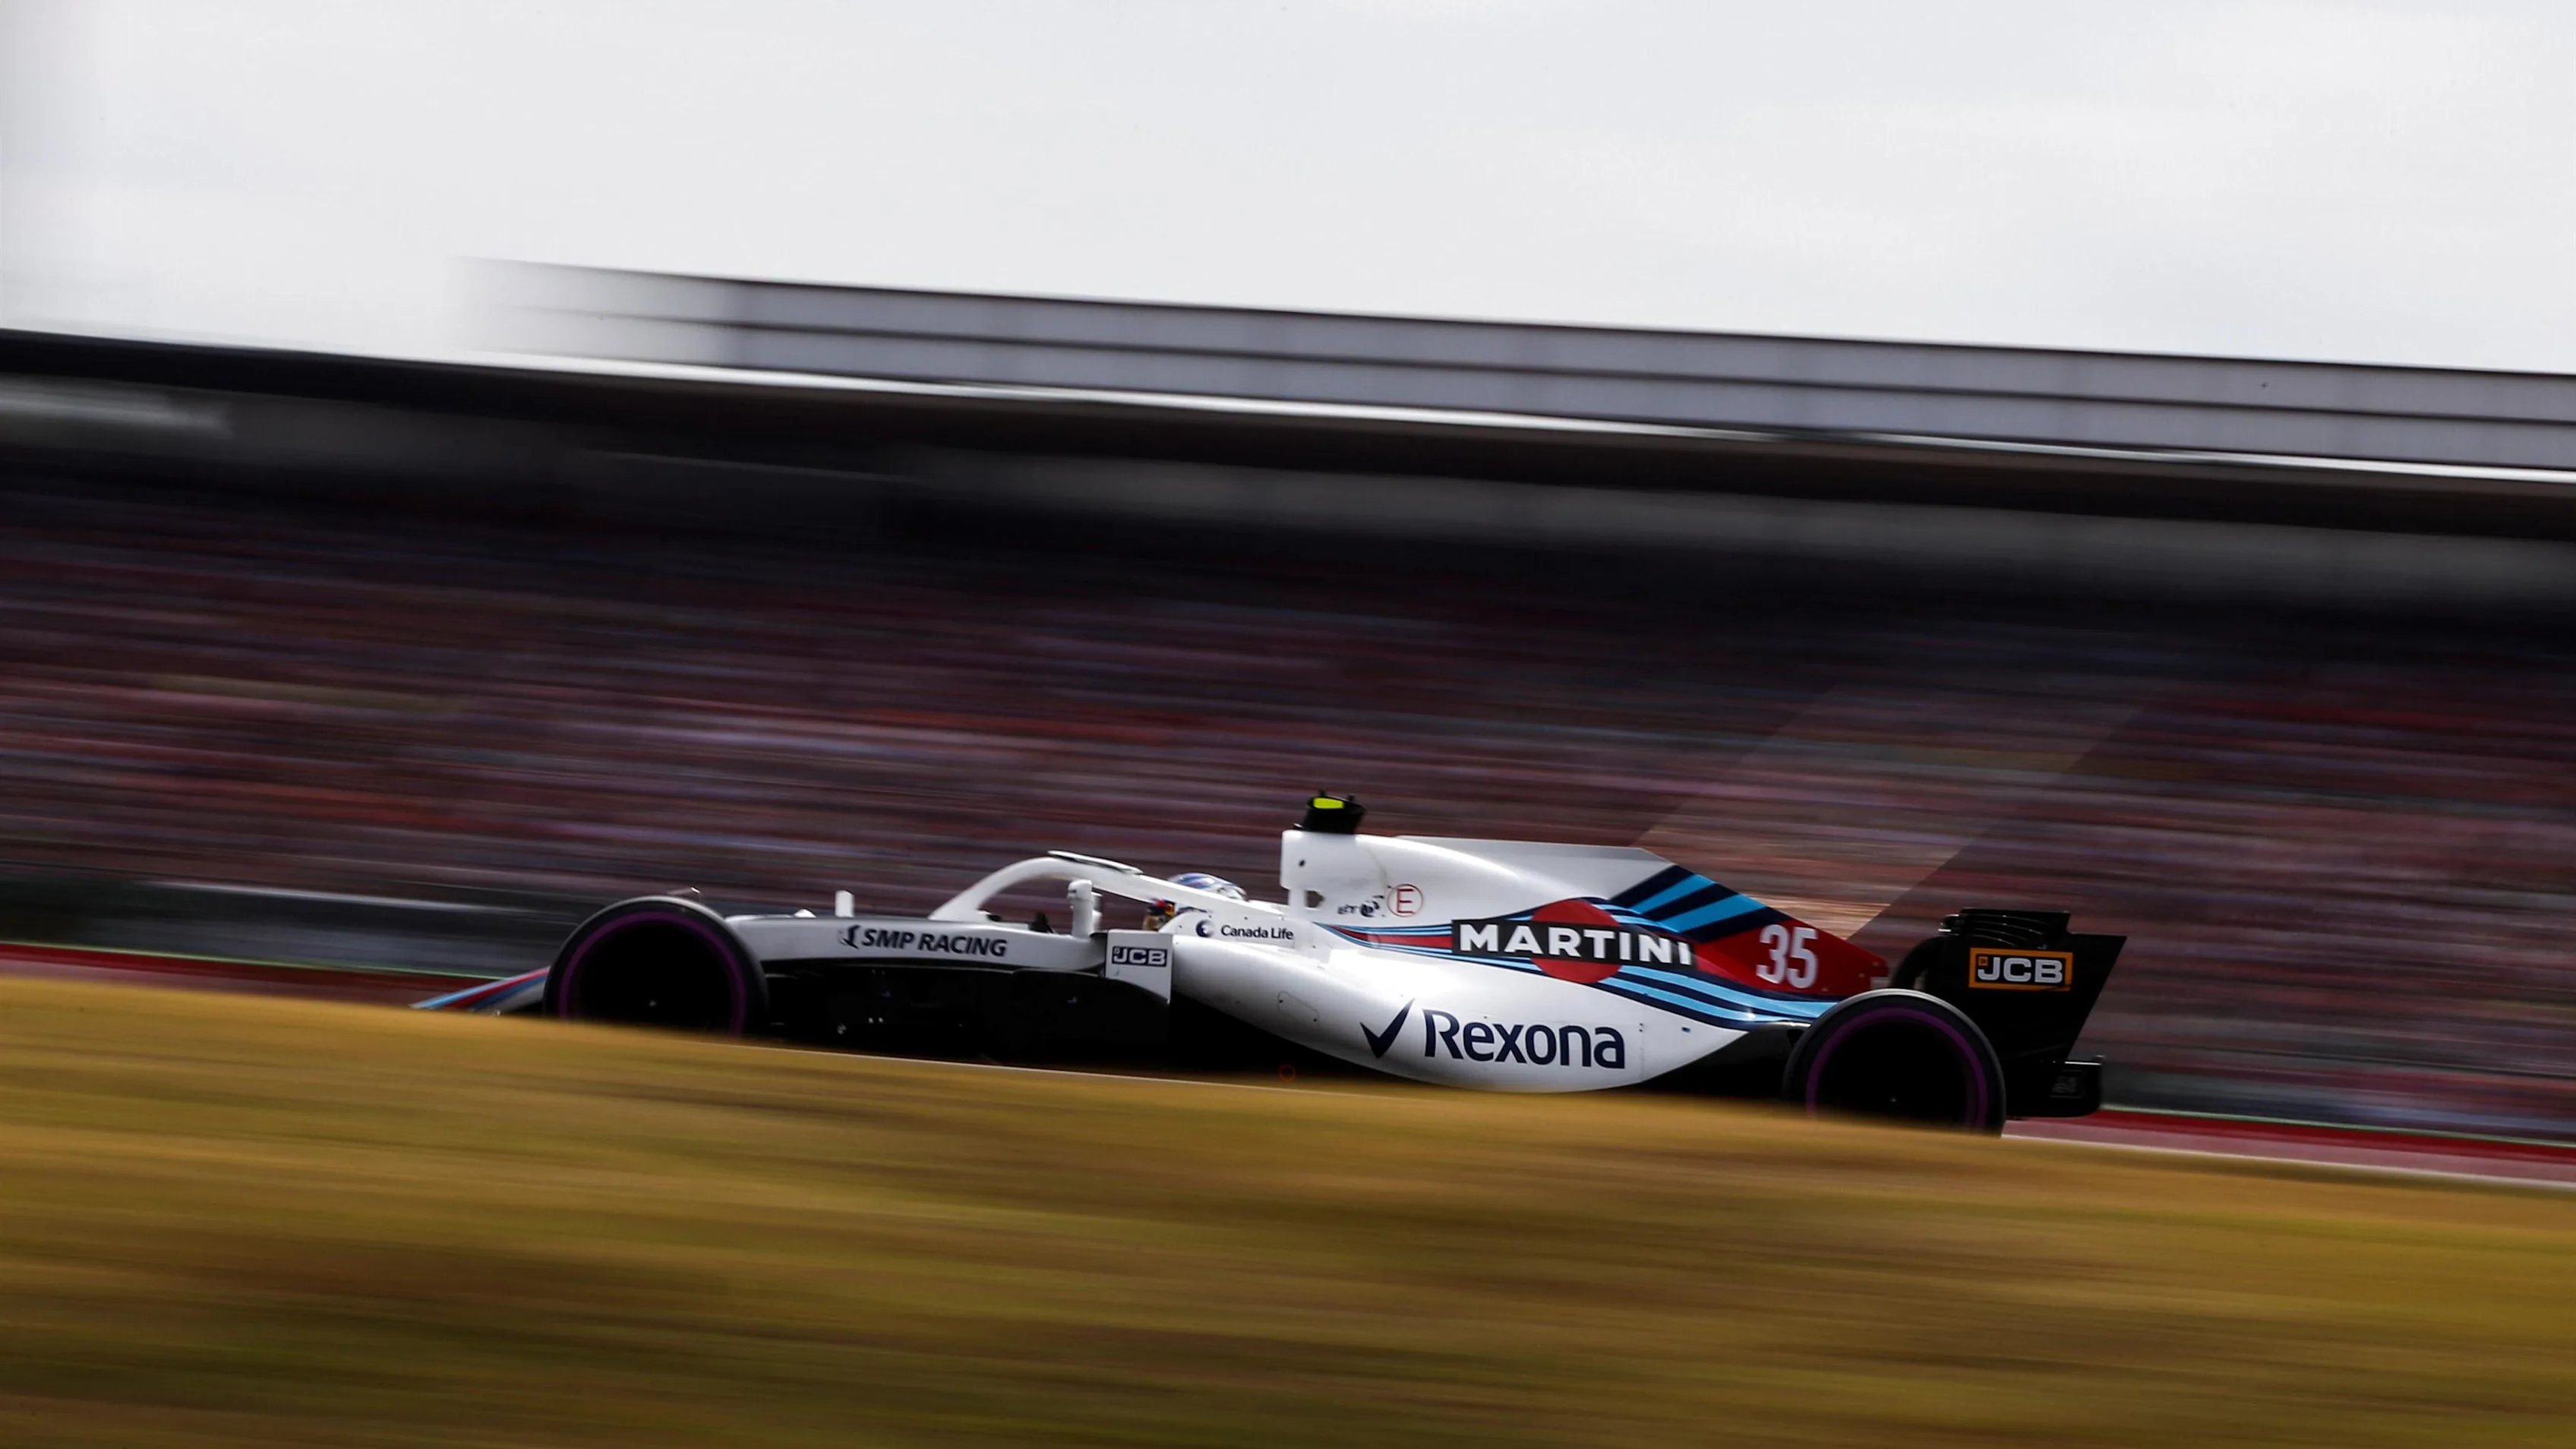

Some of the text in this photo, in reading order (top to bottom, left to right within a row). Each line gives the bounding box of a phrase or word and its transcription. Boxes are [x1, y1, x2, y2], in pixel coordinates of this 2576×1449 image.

[1396, 888, 1416, 914] E
[862, 928, 1008, 957] SMP RACING
[1221, 924, 1294, 939] Canada Life
[1460, 923, 1692, 966] MARTINI
[1113, 947, 1166, 965] JCB
[1757, 923, 1818, 989] 35
[1978, 957, 2063, 984] JCB
[1423, 1009, 1626, 1069] Rexona
